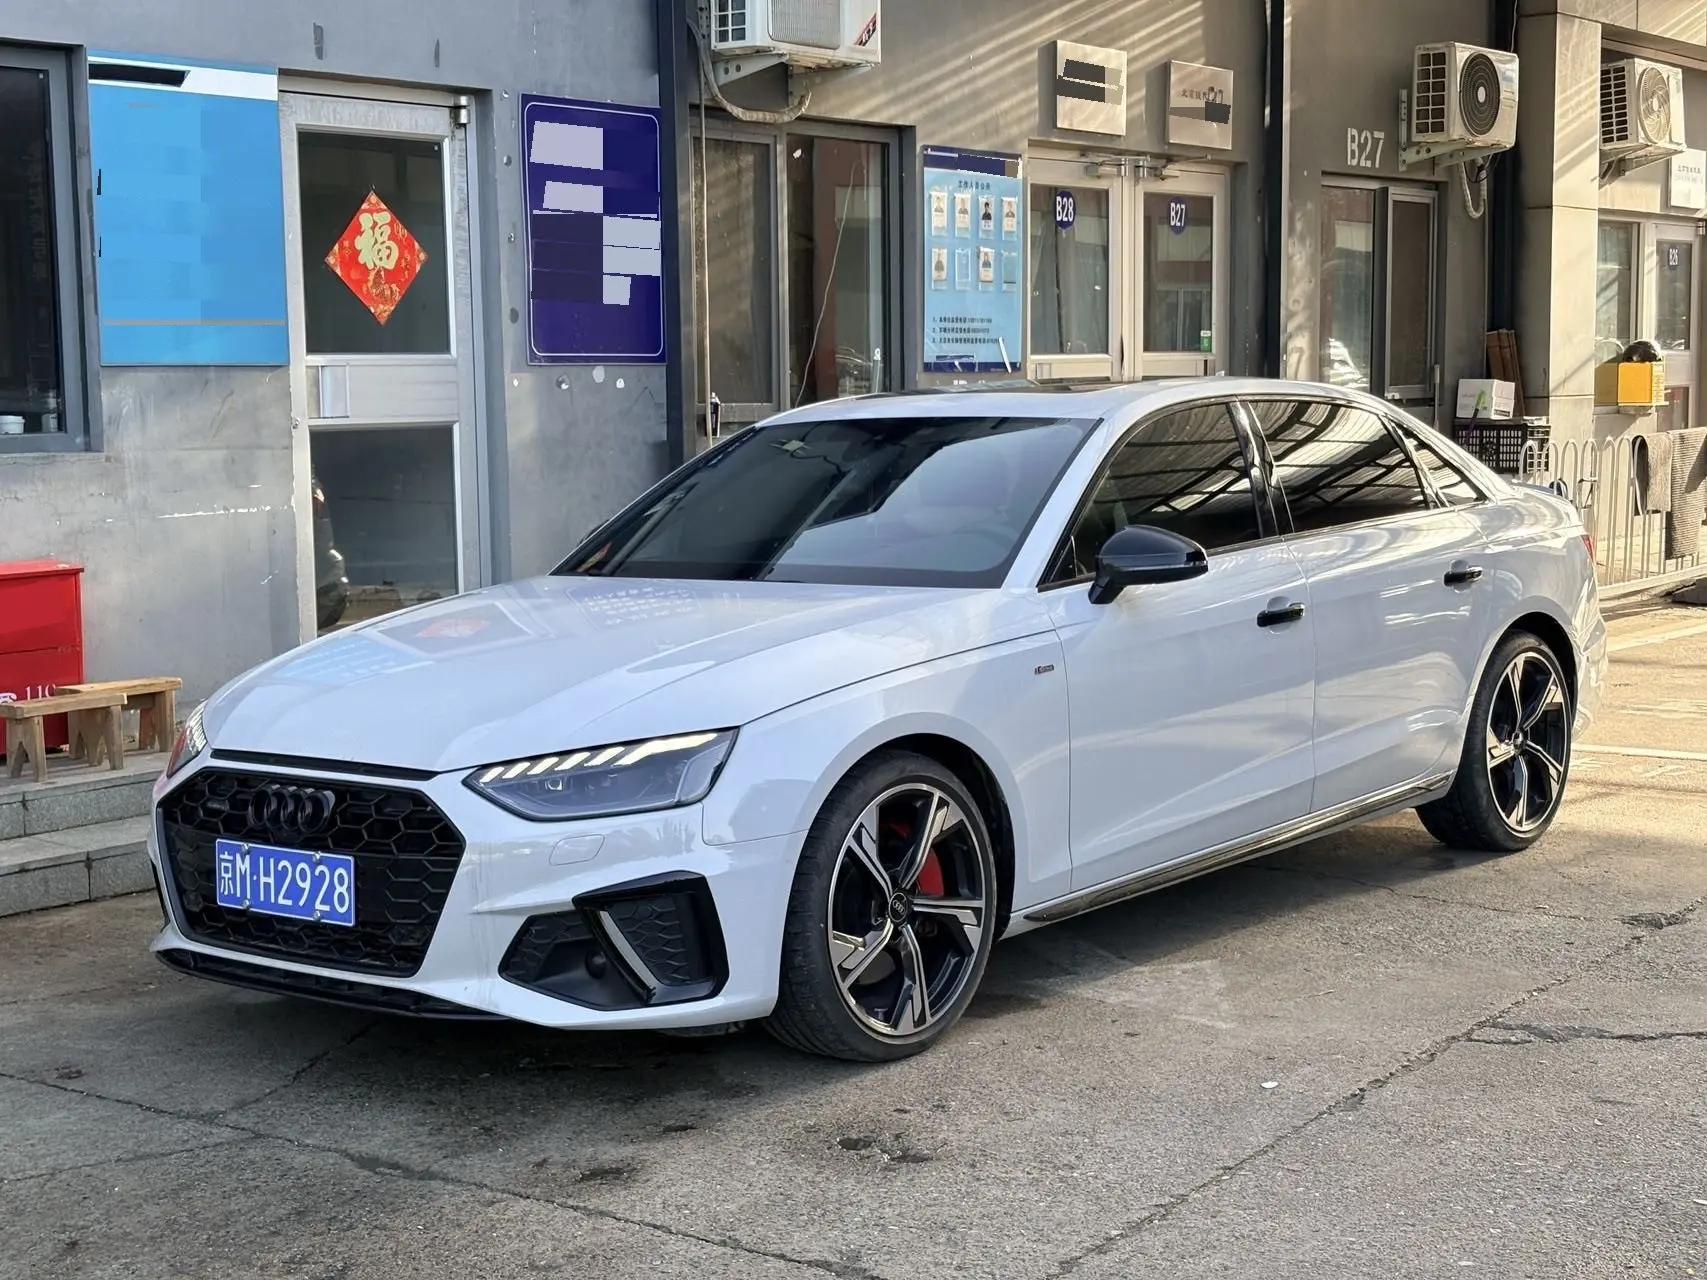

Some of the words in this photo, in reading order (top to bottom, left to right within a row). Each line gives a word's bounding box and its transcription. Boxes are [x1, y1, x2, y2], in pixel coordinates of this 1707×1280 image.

[1347, 128, 1385, 168] B27
[1056, 196, 1074, 222] B28
[1170, 202, 1186, 227] B27
[354, 211, 399, 271] 福
